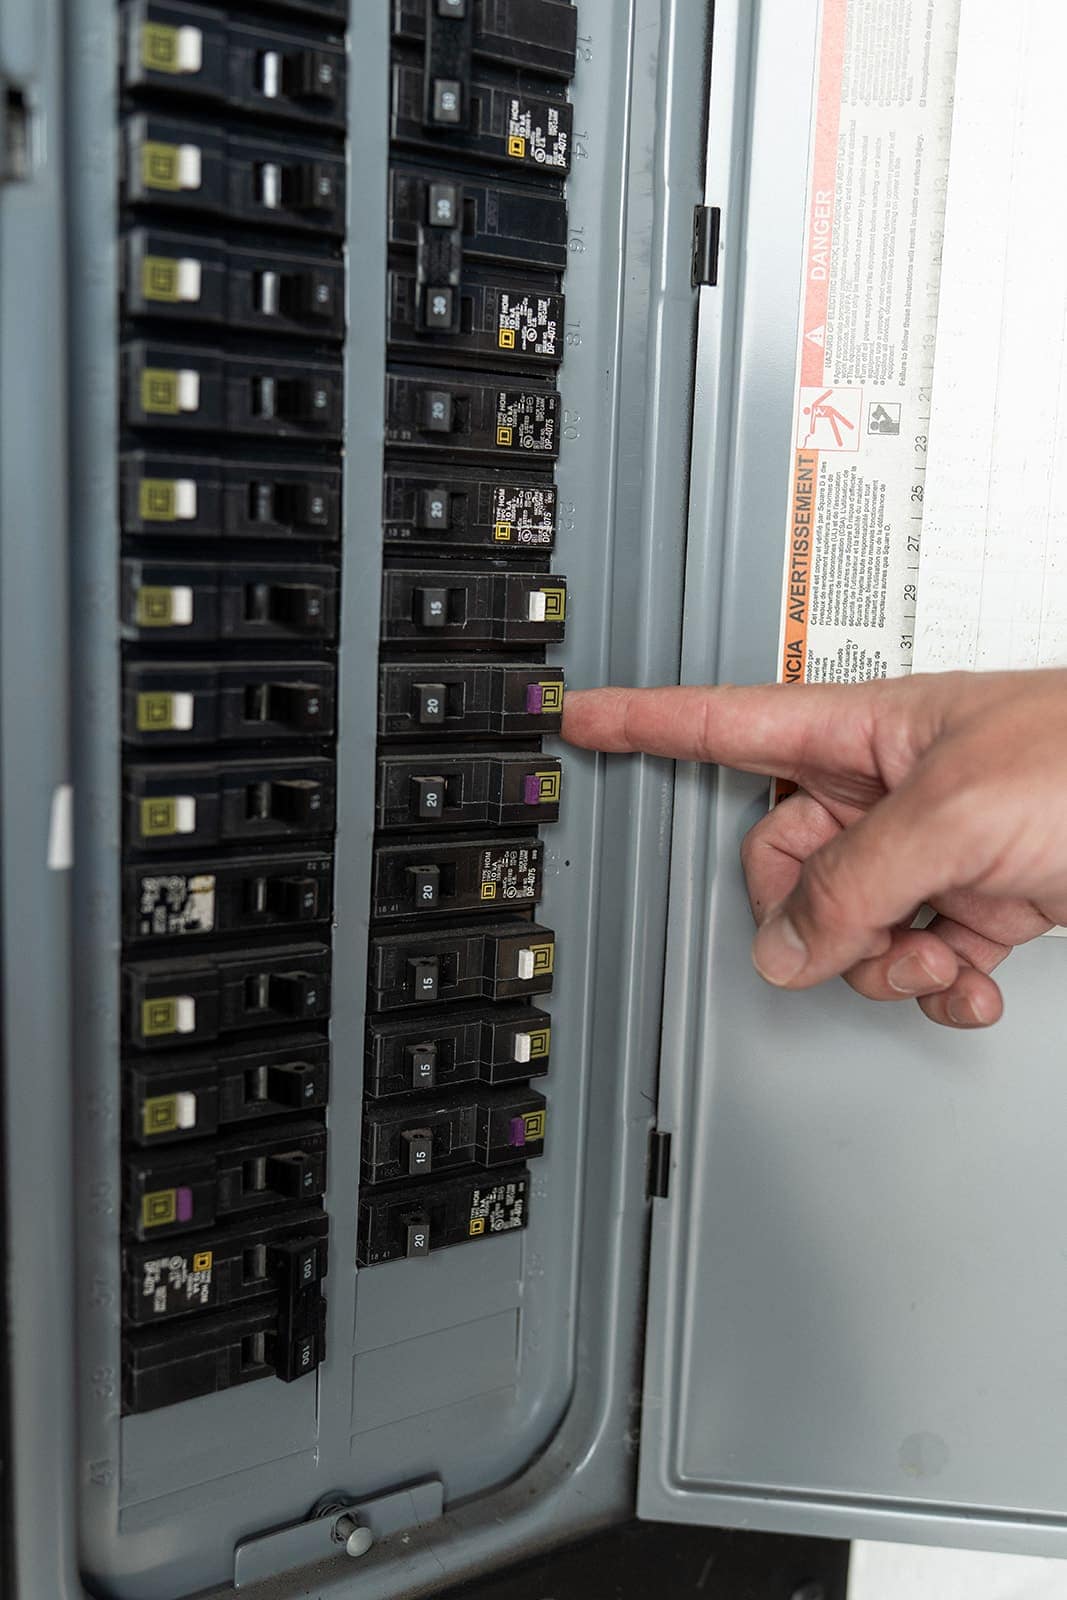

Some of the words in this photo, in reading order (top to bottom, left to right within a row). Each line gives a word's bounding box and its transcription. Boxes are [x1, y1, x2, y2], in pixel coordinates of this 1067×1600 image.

[811, 190, 832, 280] DANGER
[919, 387, 930, 402] 21
[432, 402, 444, 419] 20
[545, 419, 553, 449] DP-4075
[915, 436, 927, 452] 23
[911, 486, 923, 502] 25
[431, 501, 443, 518] 20
[789, 455, 814, 624] AVERTISSEMENT
[908, 536, 919, 551] 27
[905, 585, 916, 601] 29
[431, 601, 442, 616] 15
[901, 634, 912, 649] 31
[427, 699, 438, 713] 20
[427, 793, 437, 807] 20
[527, 868, 536, 896] DP-4075
[423, 885, 433, 899] 20
[423, 977, 433, 990] 15
[420, 1064, 430, 1077] 15
[415, 1151, 426, 1163] 15
[414, 1234, 424, 1247] 20
[303, 1258, 312, 1278] 100
[302, 1345, 310, 1365] 100
